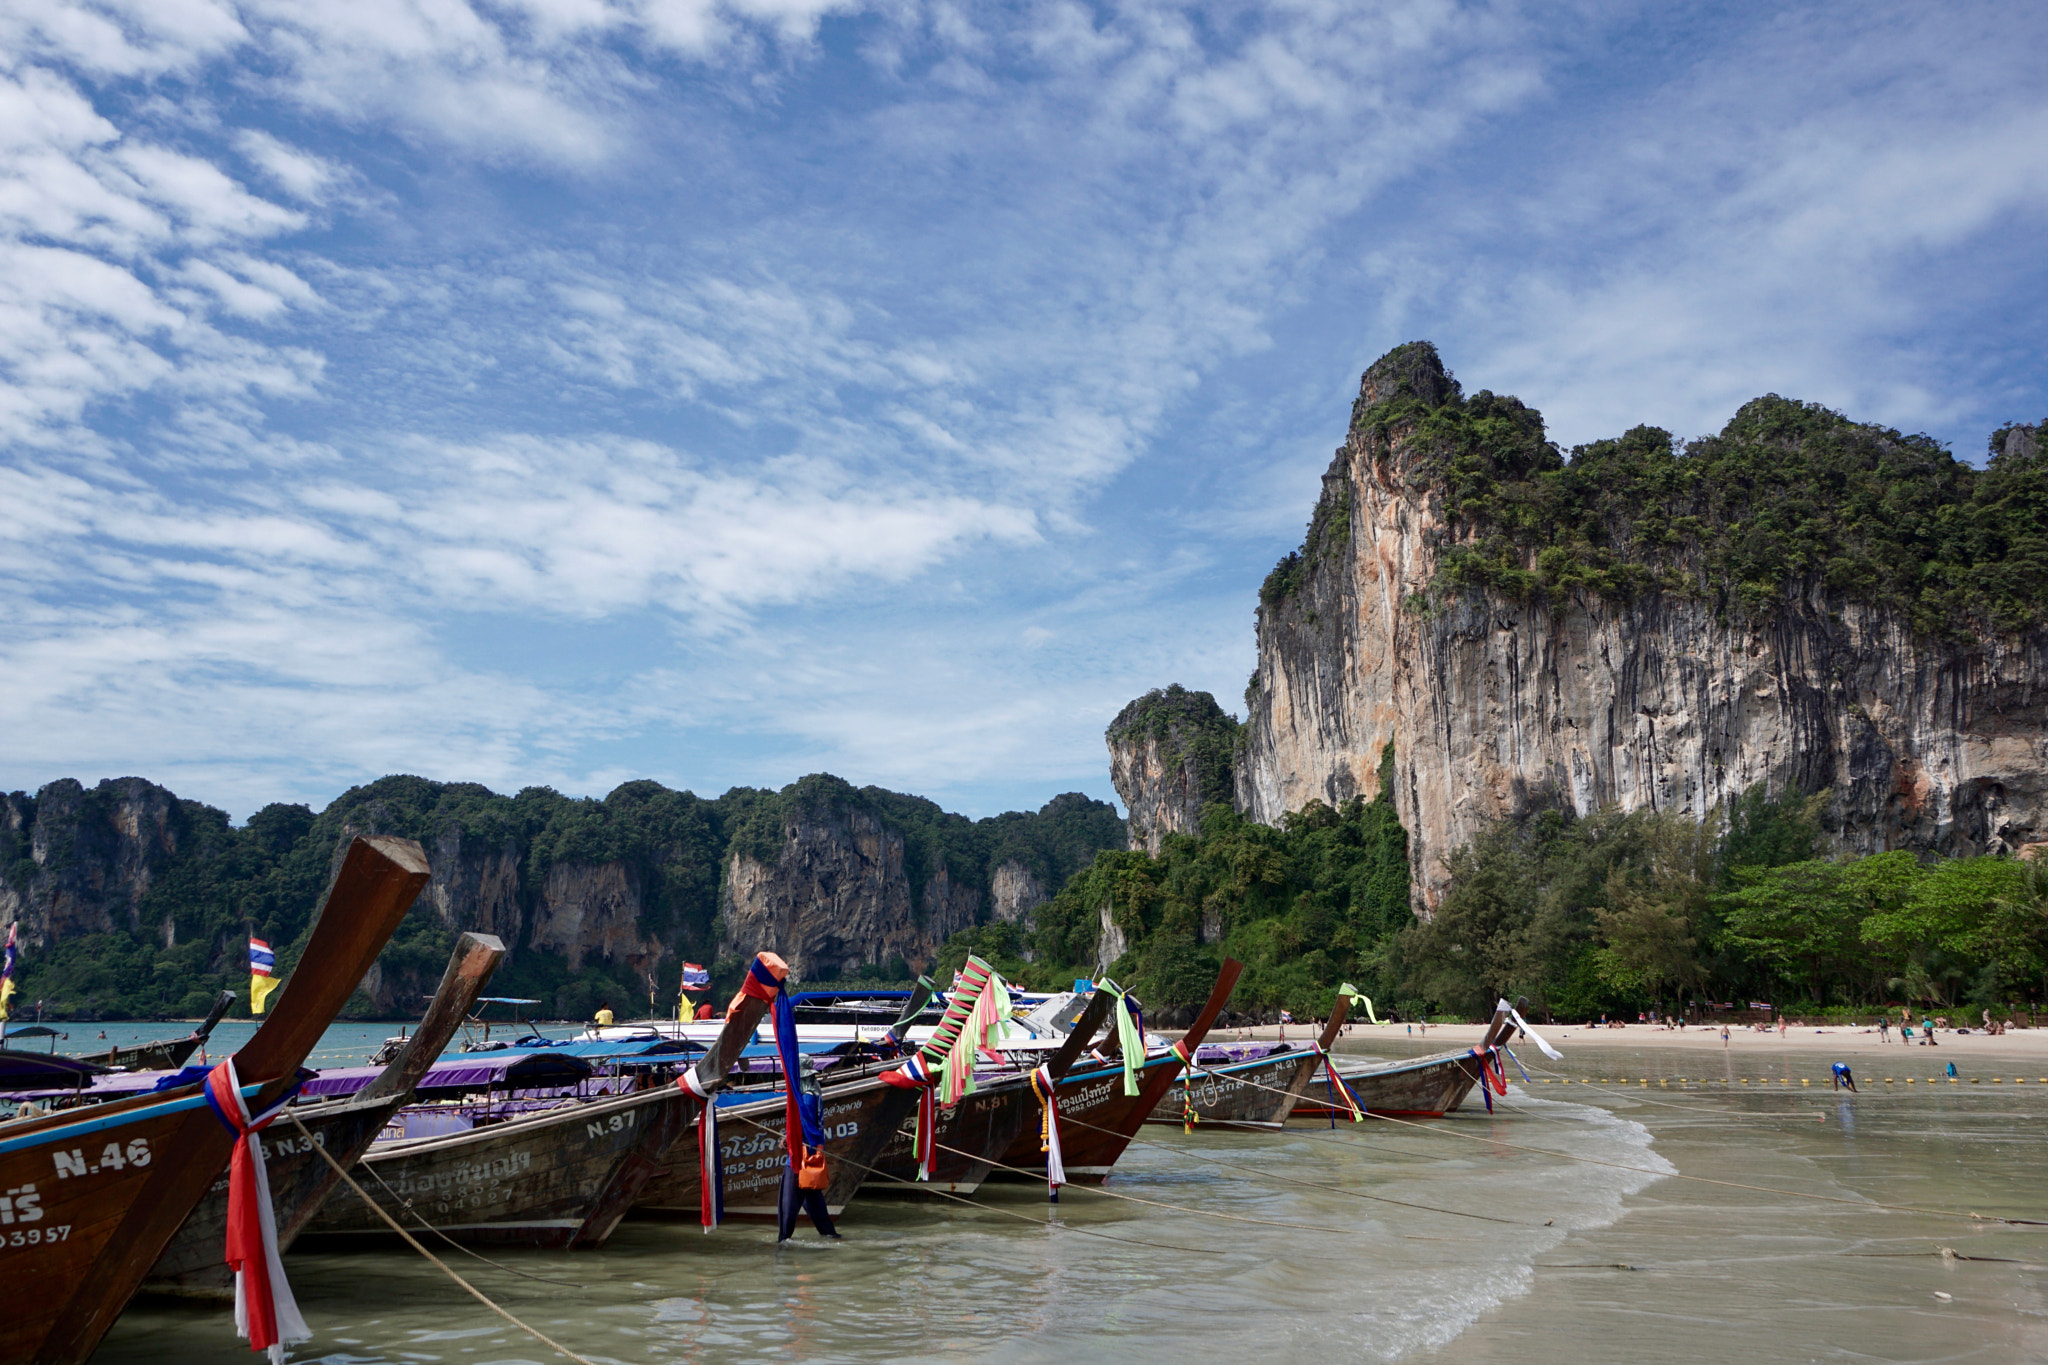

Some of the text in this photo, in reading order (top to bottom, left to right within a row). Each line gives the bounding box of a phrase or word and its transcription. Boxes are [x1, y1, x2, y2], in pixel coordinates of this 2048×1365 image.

[1275, 1058, 1297, 1071] N.21
[586, 1109, 636, 1140] N.37
[836, 1121, 859, 1138] 03
[52, 1137, 152, 1180] N.46
